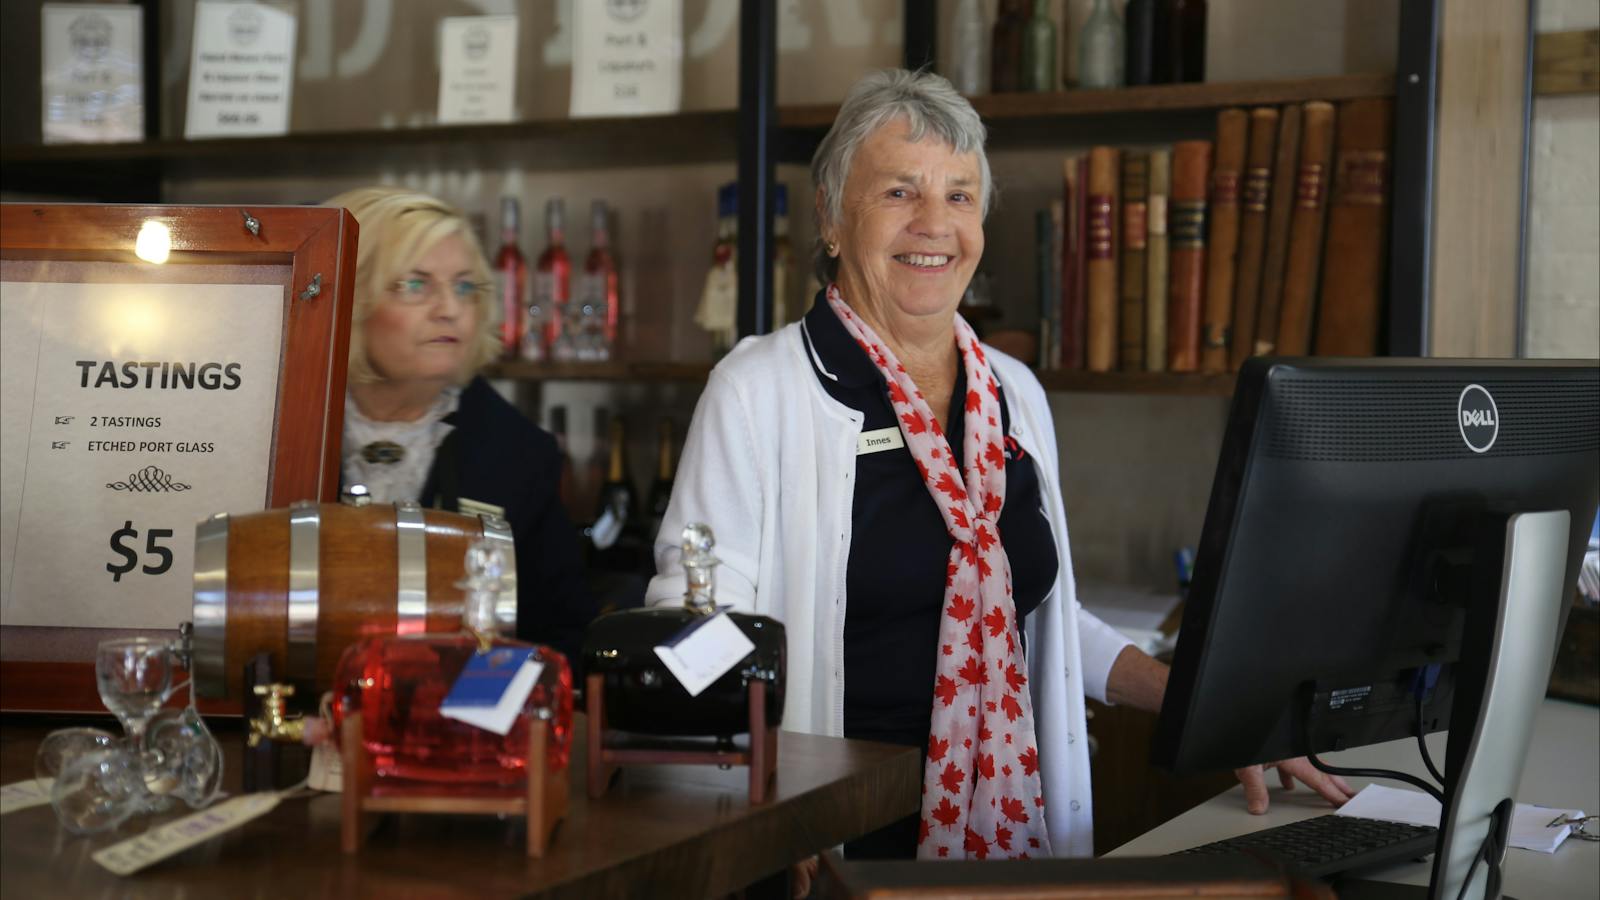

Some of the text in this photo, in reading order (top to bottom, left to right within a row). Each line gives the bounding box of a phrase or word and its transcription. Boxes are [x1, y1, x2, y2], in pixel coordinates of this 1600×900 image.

[76, 360, 242, 390] TASTINGS
[90, 416, 162, 428] 2 TASTINGS
[1462, 409, 1495, 427] DELL
[88, 441, 215, 453] ETCHED PORT GLASS
[866, 437, 892, 447] Innes
[106, 520, 174, 583] $5
